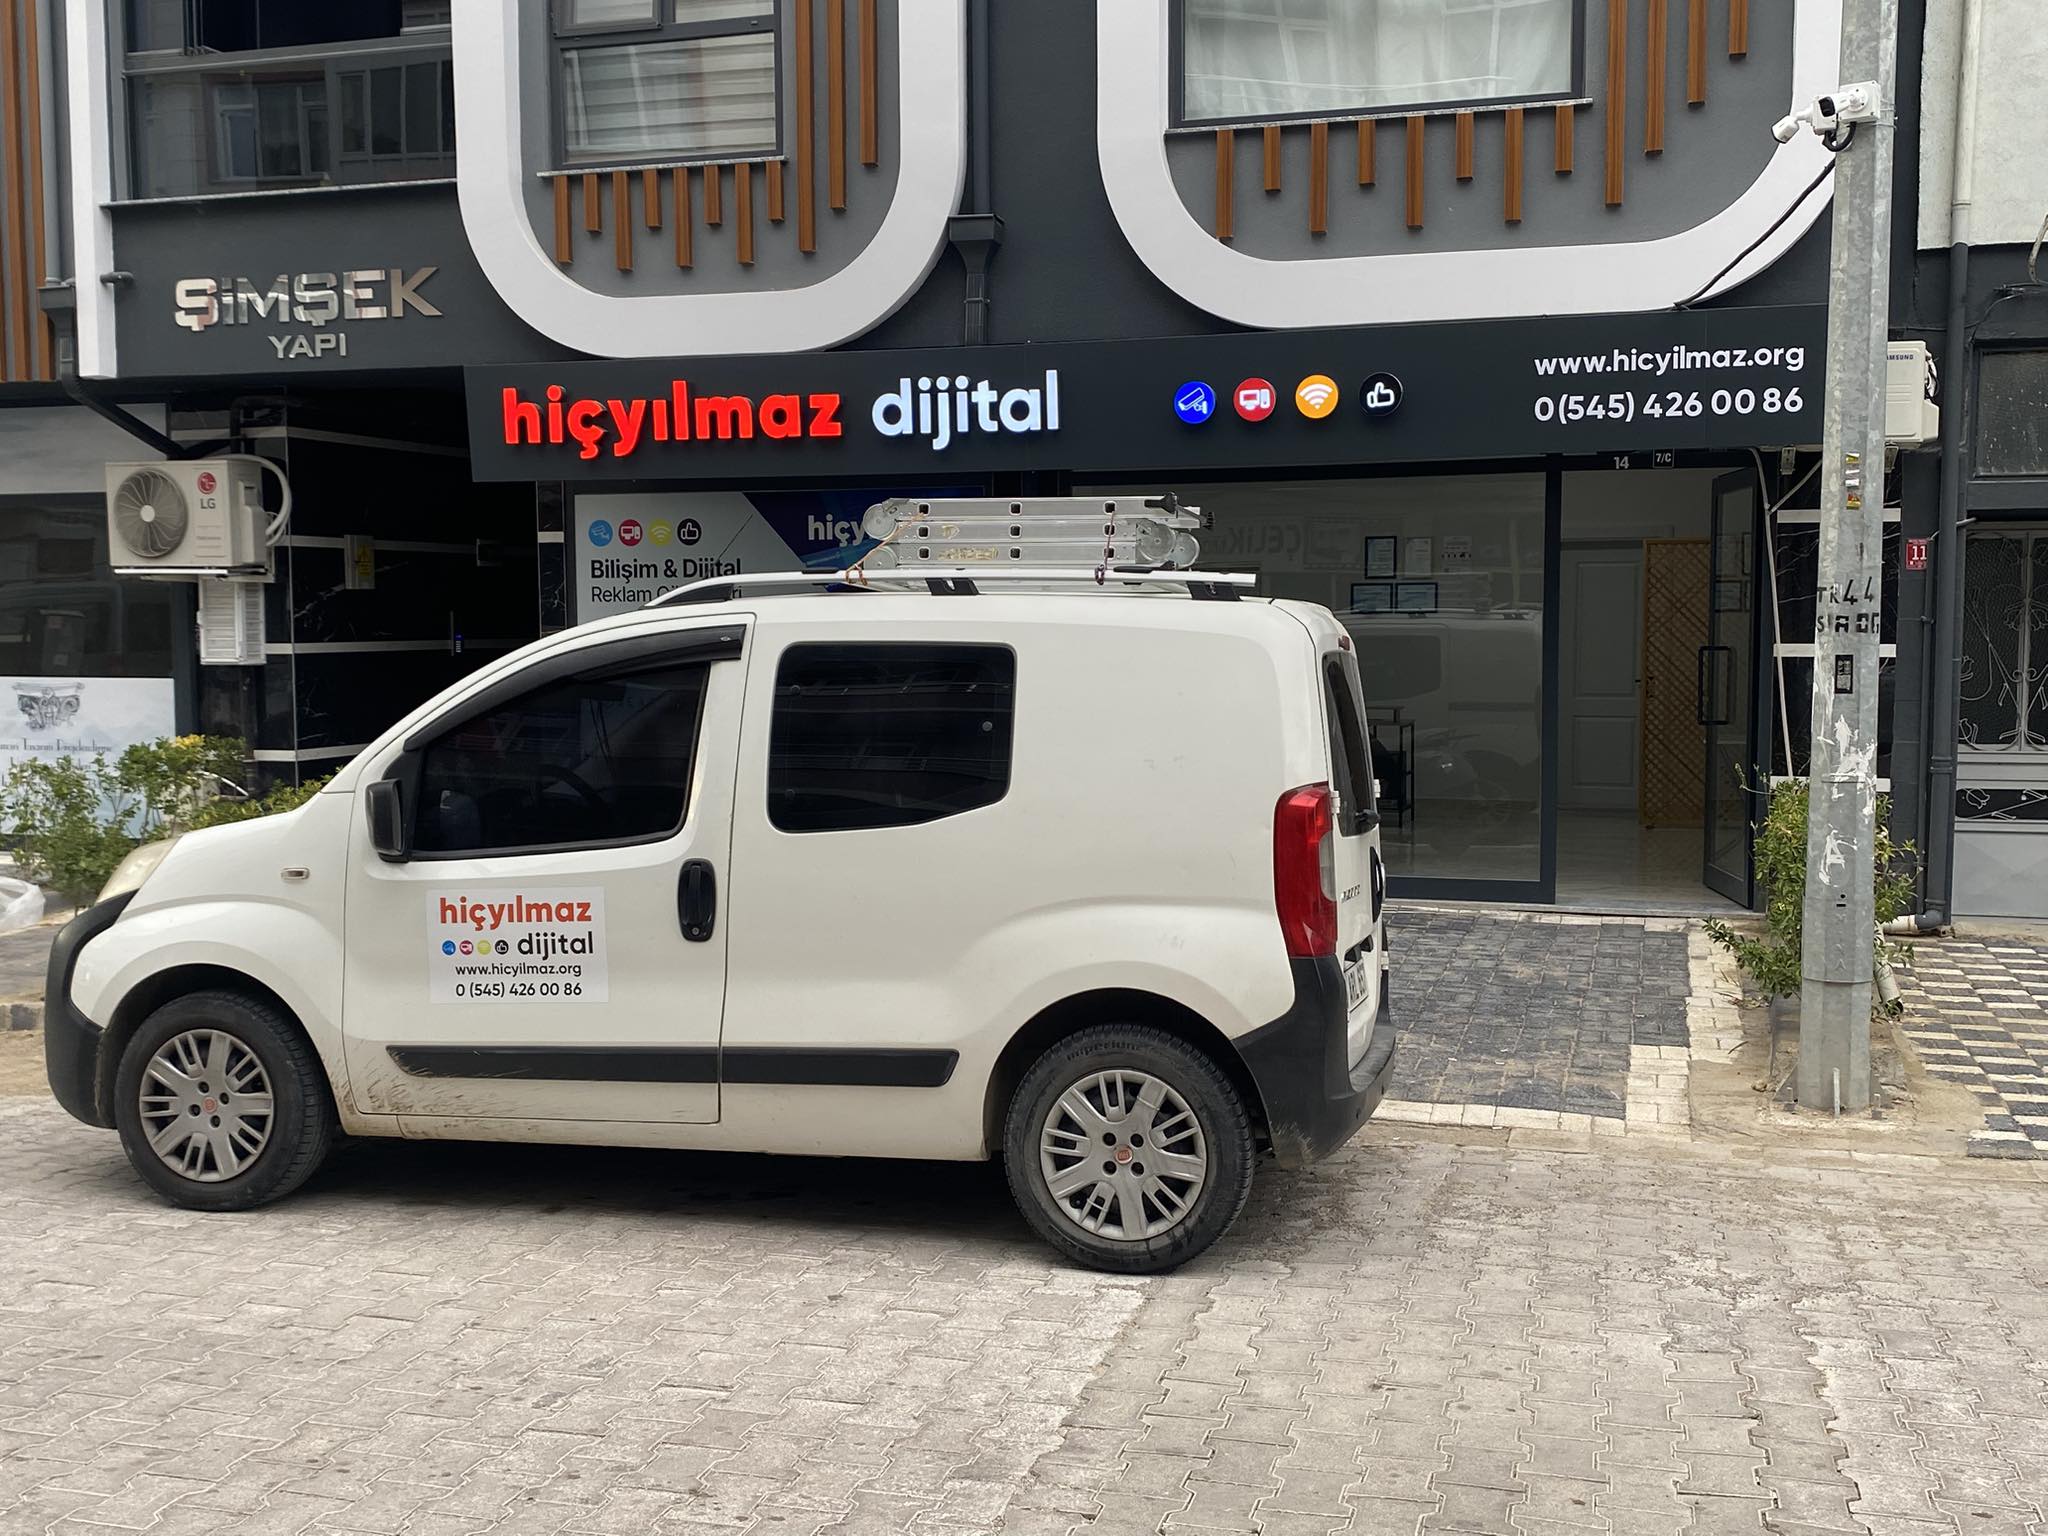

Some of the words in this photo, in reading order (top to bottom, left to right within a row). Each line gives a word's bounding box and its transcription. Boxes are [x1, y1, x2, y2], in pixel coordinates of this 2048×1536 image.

[267, 333, 347, 359] YAPI
[1534, 345, 1805, 376] www.hicyilmaz.org
[1643, 391, 1703, 418] 426
[1711, 389, 1755, 415] 00
[1762, 387, 1804, 413] 86
[502, 380, 843, 459] hiçyılmaz
[871, 369, 1059, 450] dijital
[1613, 456, 1630, 469] 14
[1655, 452, 1672, 464] 7/C
[200, 498, 216, 510] LG
[1911, 545, 1927, 560] 11
[591, 558, 658, 583] Bilişim
[663, 558, 678, 578] &
[591, 586, 651, 603] Reklam
[439, 895, 592, 931] hiçyılmaz
[517, 931, 594, 960] dijital
[455, 963, 582, 977] www.hicyilmaz.org
[470, 982, 505, 998] (545)
[509, 983, 536, 996] 426
[540, 983, 560, 996] 00
[564, 982, 582, 996] 86
